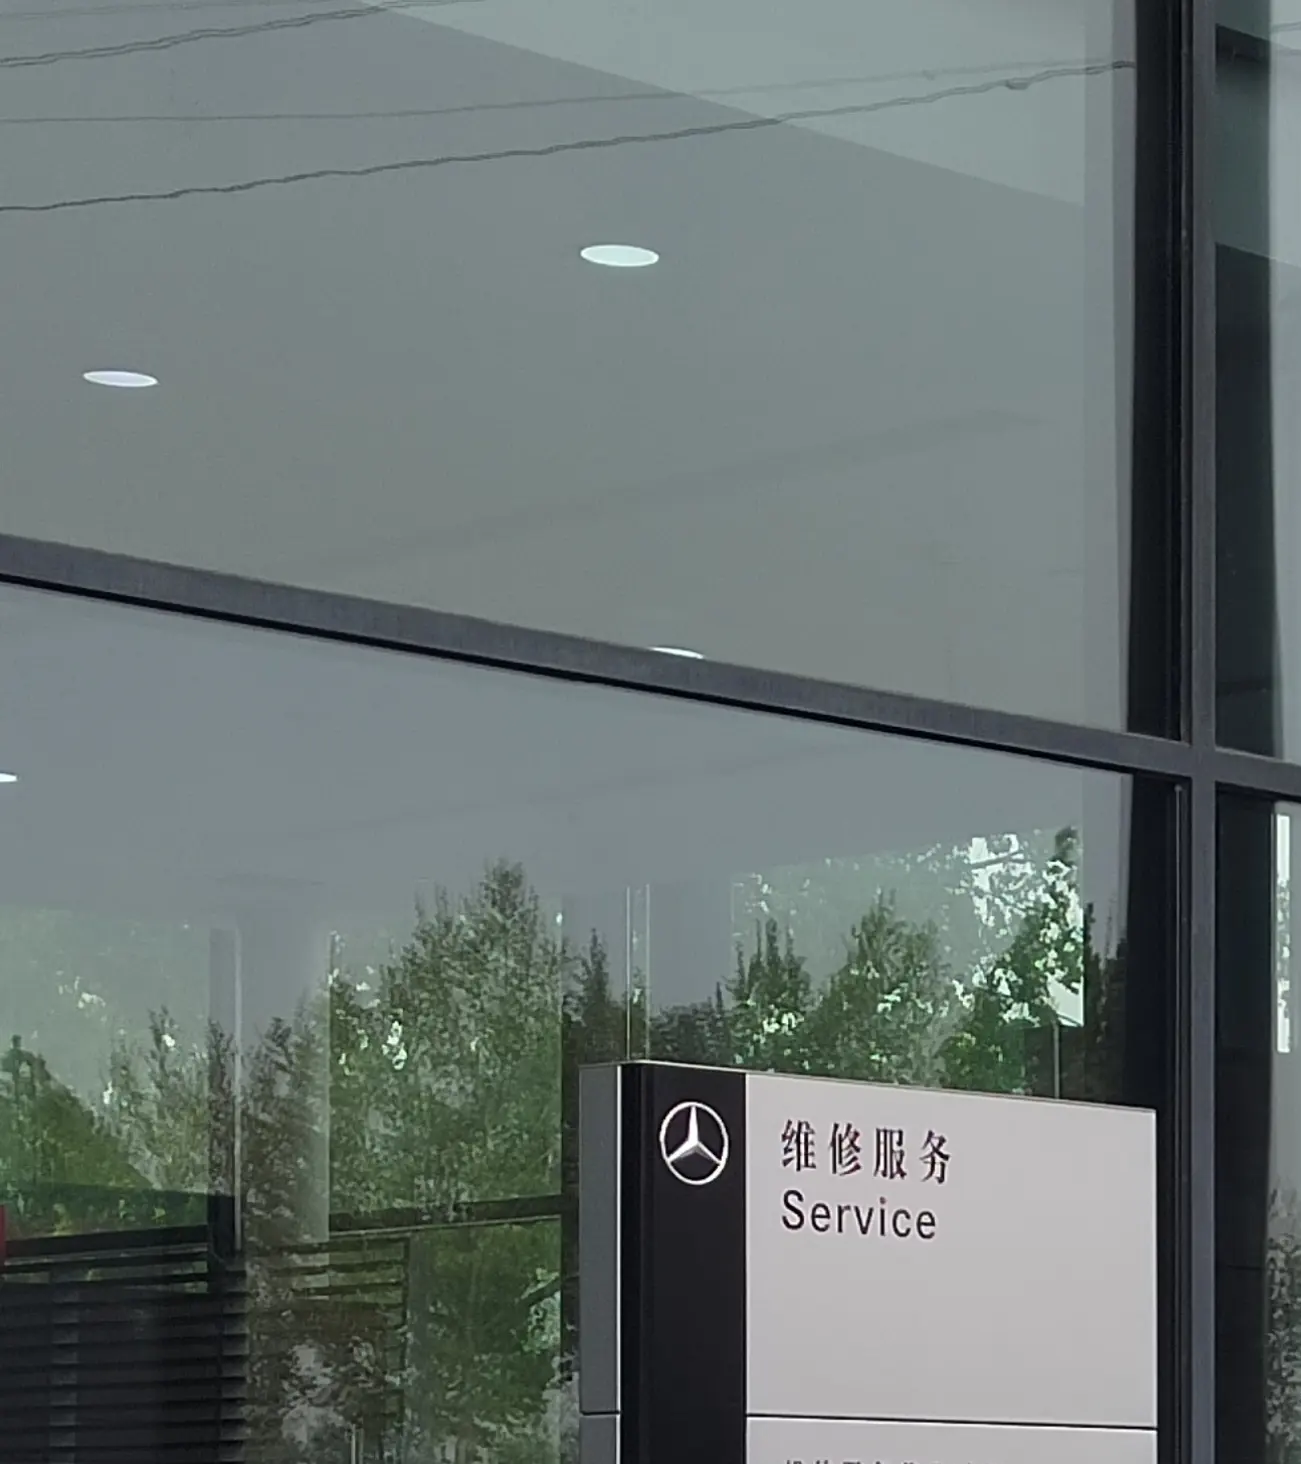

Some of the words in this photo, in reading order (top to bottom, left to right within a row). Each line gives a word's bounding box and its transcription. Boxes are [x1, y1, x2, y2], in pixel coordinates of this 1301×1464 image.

[781, 1119, 951, 1184] 维修服务
[782, 1189, 936, 1239] Service
